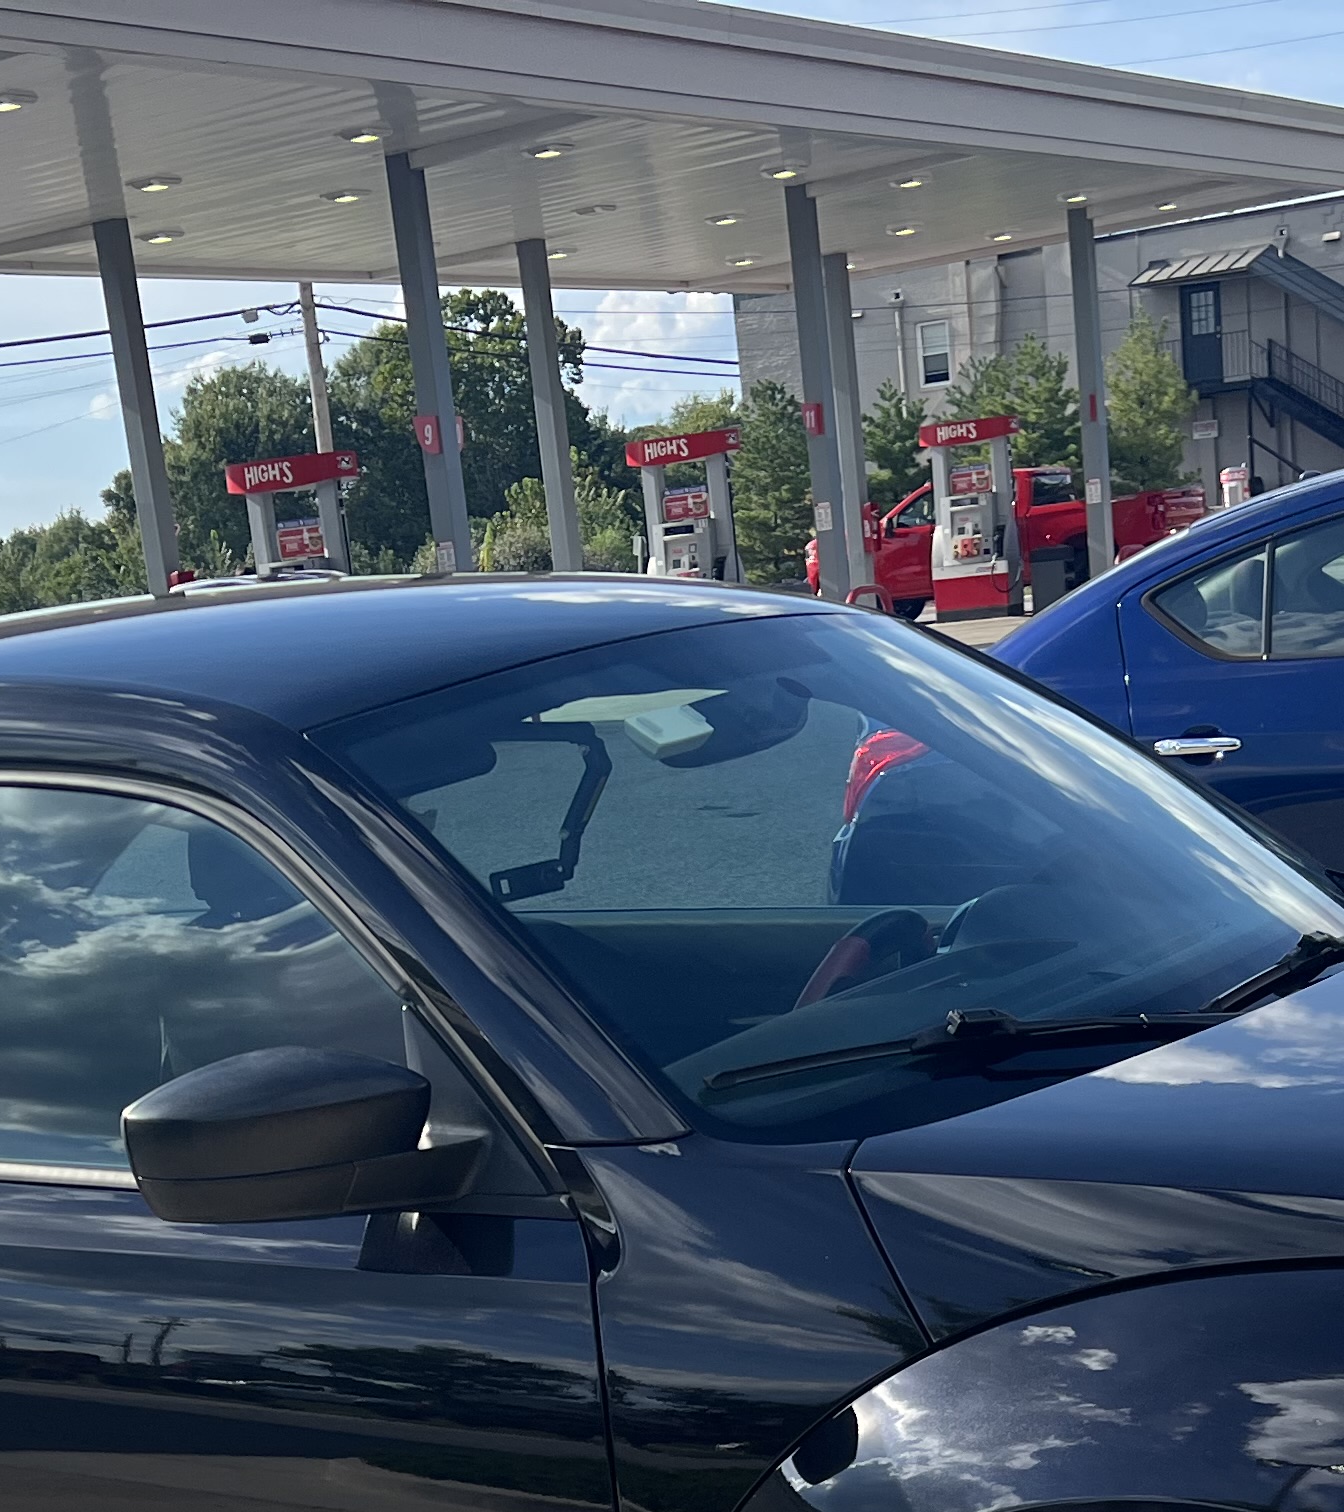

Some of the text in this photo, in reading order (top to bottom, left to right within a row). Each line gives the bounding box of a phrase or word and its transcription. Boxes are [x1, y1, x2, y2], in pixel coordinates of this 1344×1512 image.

[806, 410, 815, 428] 11
[424, 424, 433, 446] 9
[937, 422, 977, 444] HIGH'S
[644, 438, 689, 462] HIGH'S
[244, 461, 293, 490] HIGH'S
